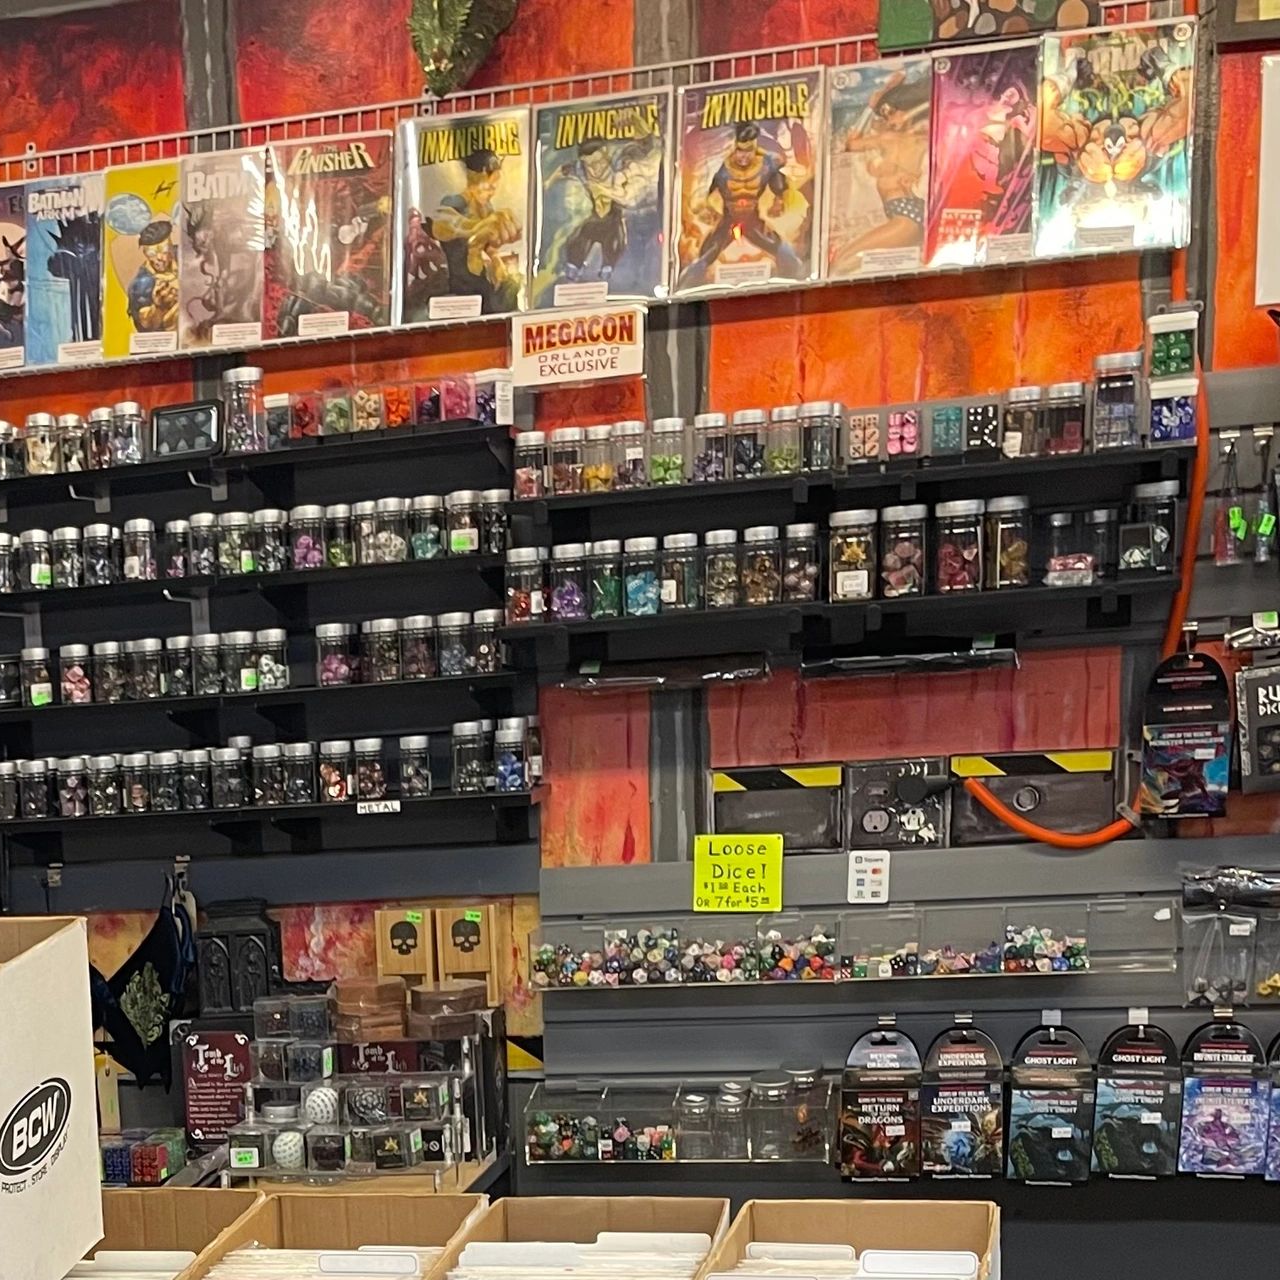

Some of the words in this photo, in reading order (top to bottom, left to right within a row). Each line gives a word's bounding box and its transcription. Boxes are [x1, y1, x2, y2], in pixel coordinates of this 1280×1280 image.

[702, 83, 809, 129] INVINCIBLE
[419, 120, 521, 166] INVINCIBLE
[288, 143, 375, 176] PUNISHER
[524, 313, 635, 354] MEGACON
[538, 346, 620, 364] ORLANDO
[539, 356, 619, 377] EXCLUSIVE
[360, 801, 397, 813] METAL
[708, 841, 767, 856] Loose
[712, 863, 766, 880] Dice!
[733, 882, 766, 894] Each
[714, 896, 723, 909] 7
[725, 896, 742, 908] for
[191, 1043, 222, 1074] Tomb
[352, 1043, 383, 1071] Tomb
[938, 1059, 987, 1067] EXPEDITIONS
[1024, 1057, 1052, 1065] GHOST
[1053, 1057, 1078, 1065] LIGHT
[1112, 1055, 1140, 1063] GHOST
[1141, 1055, 1167, 1064] LIGHT
[861, 1104, 900, 1112] RETURN
[931, 1104, 992, 1113] EXPEDITIONS
[933, 1097, 990, 1105] UNDERDARK
[12, 1088, 60, 1161] BCW
[858, 1116, 904, 1125] DRAGONS
